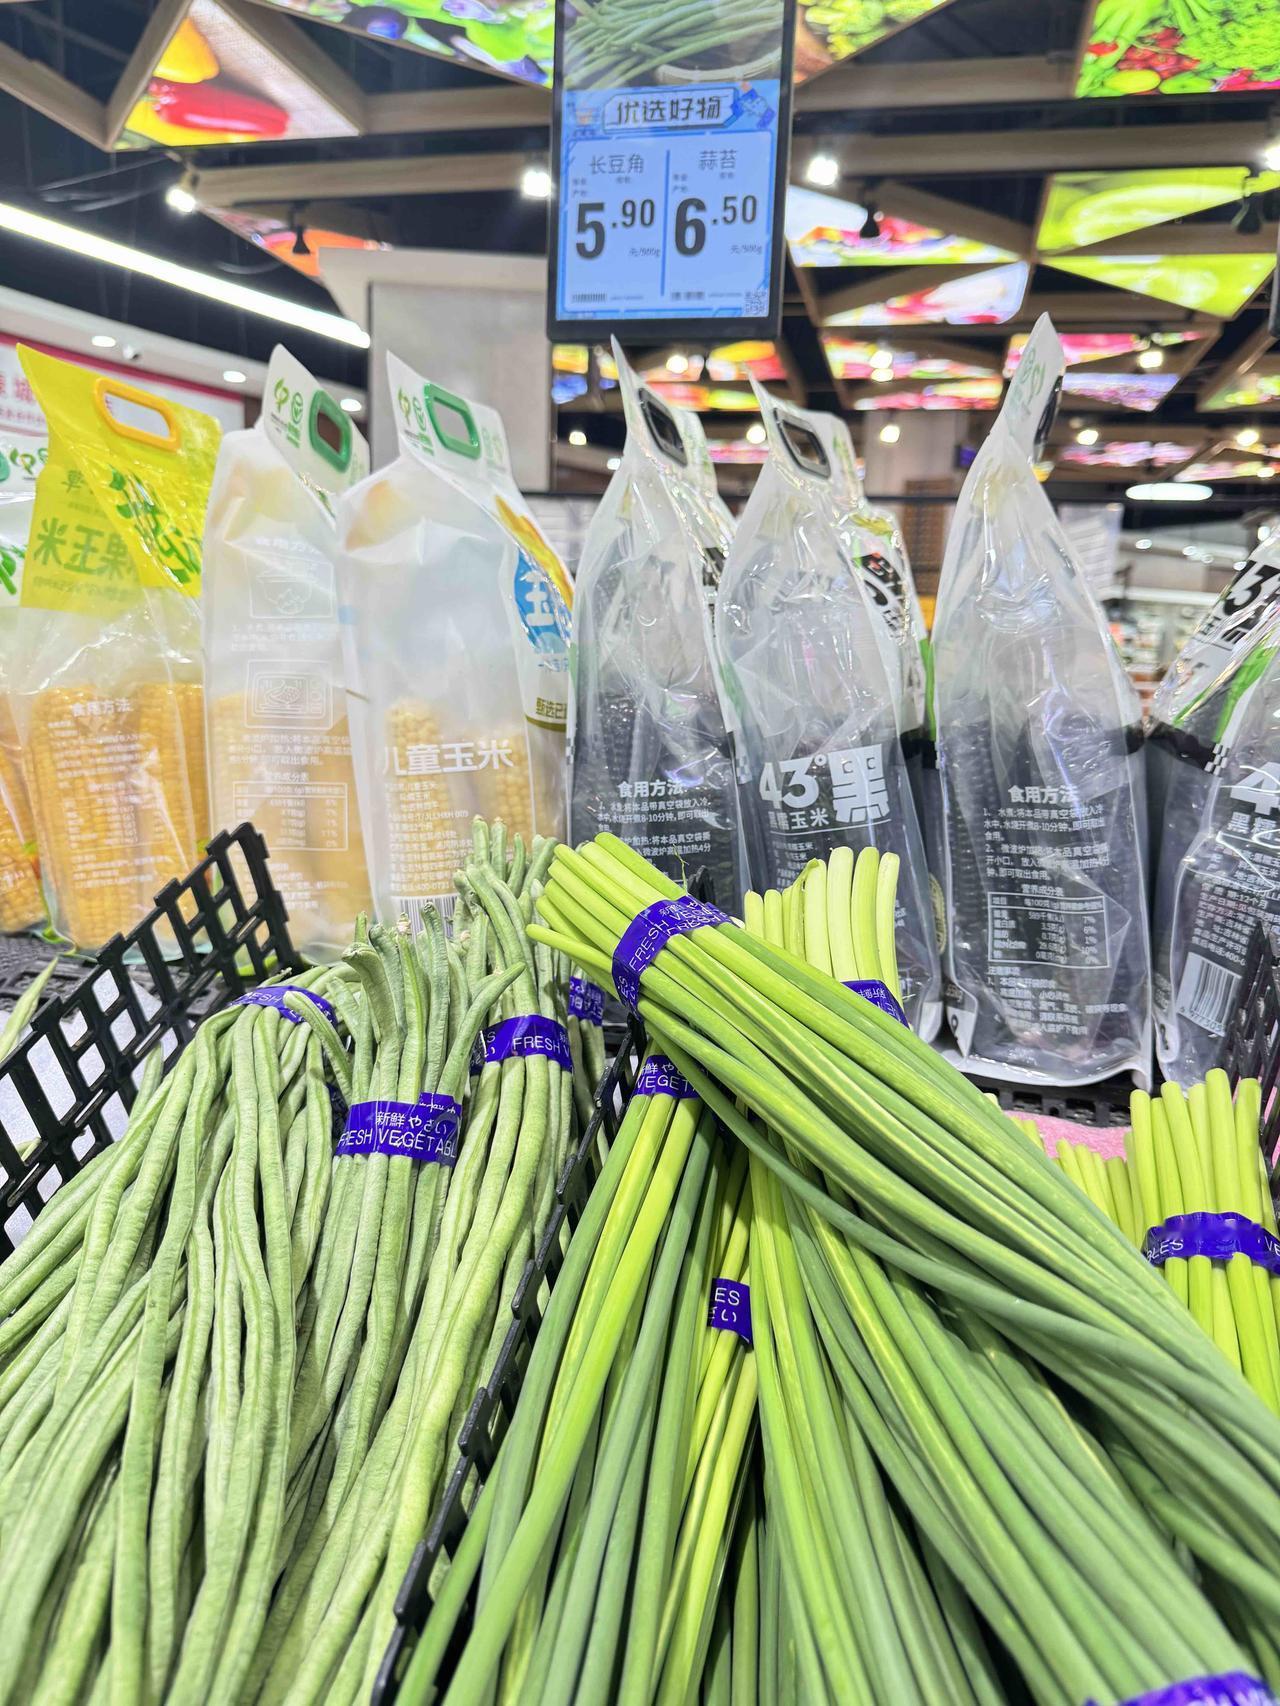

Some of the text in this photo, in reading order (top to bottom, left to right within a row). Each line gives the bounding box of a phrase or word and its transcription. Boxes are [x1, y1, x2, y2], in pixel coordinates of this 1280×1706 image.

[617, 95, 721, 125] 优选好物
[590, 153, 645, 175] 长豆角
[698, 149, 737, 171] 蒜苔
[575, 198, 656, 260] 5.90
[675, 194, 758, 257] 6.50
[383, 739, 514, 776] 儿童玉米
[618, 779, 684, 798] 食用方法
[1008, 785, 1079, 804] 食用方法
[513, 1035, 561, 1055] FRESH
[637, 1075, 695, 1093] VEGET
